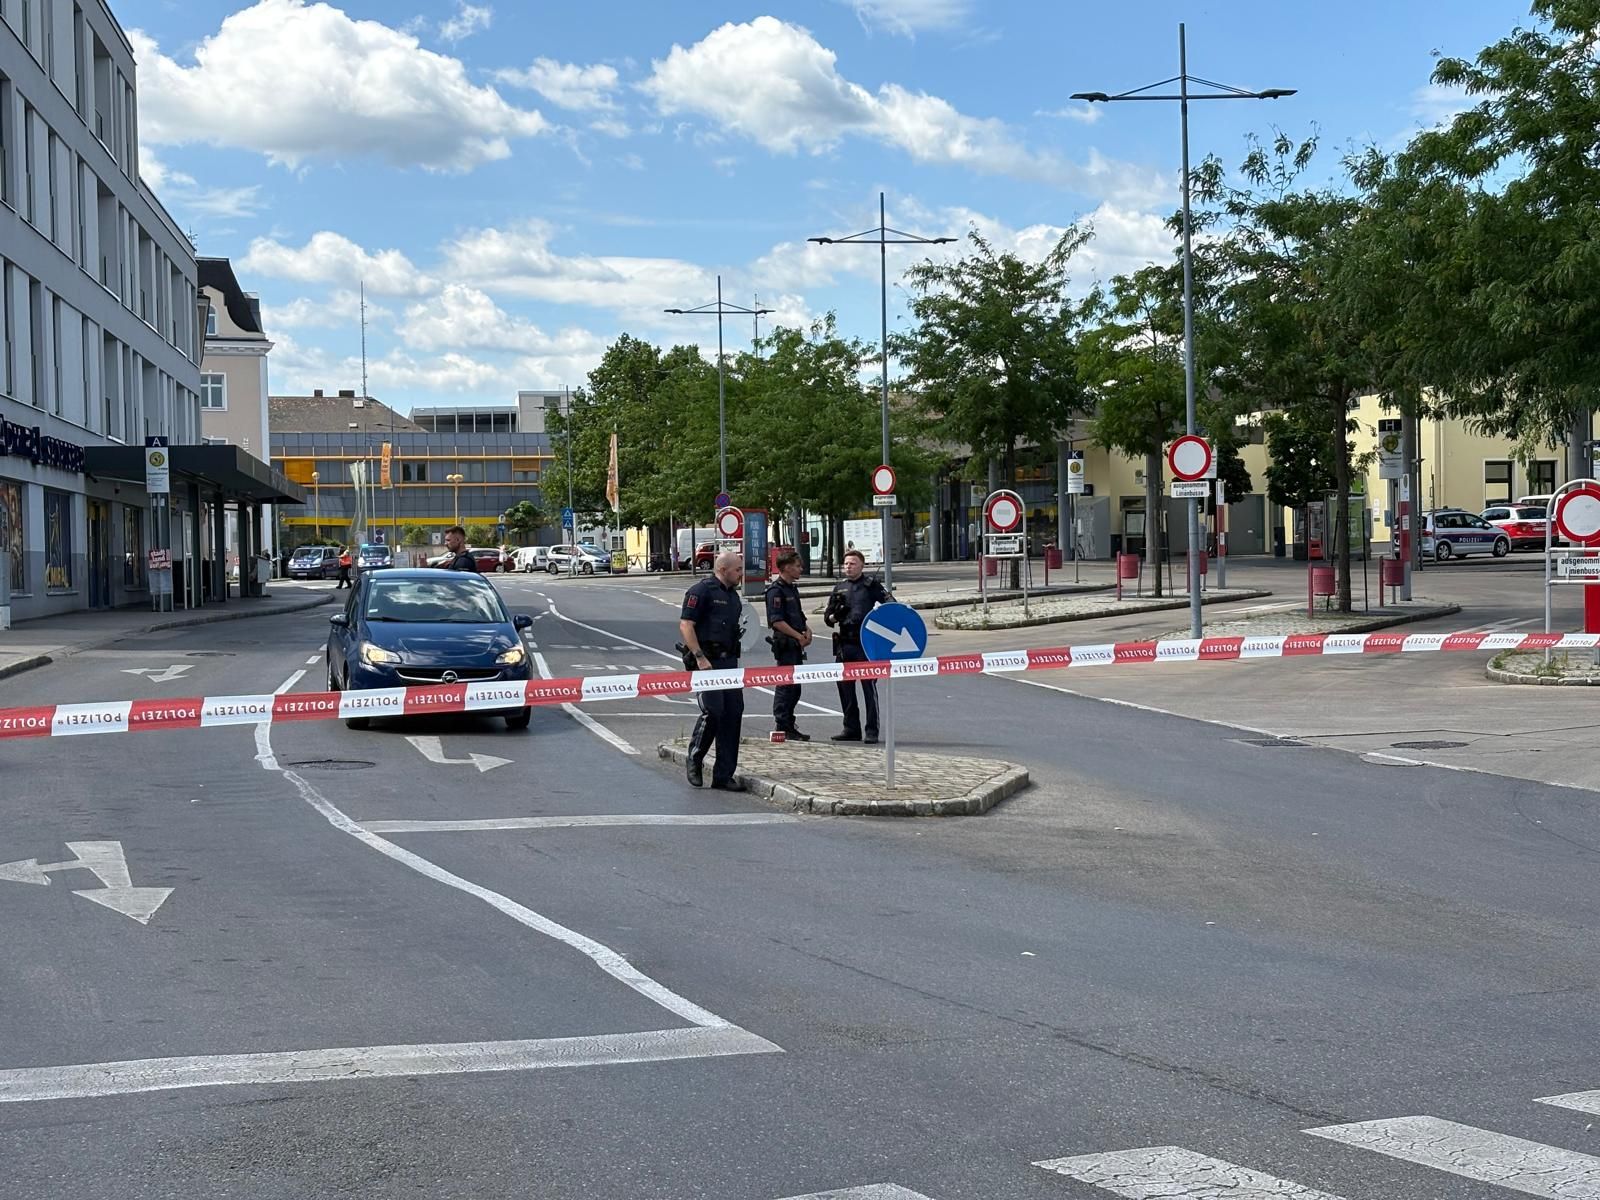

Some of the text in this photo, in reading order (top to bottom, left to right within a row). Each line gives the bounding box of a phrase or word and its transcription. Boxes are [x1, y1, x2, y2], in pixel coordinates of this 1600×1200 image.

[152, 437, 161, 446] A
[0, 717, 46, 729] POLIZ
[67, 713, 122, 725] POLIZEI
[142, 708, 196, 720] POLIZEI
[214, 704, 266, 716] POLIZEI
[285, 700, 334, 712] POLIZEI
[352, 696, 398, 708] POLIZEI
[416, 693, 460, 704] POLIZEI
[476, 690, 520, 701] POLIZEI
[536, 688, 577, 697] POLIZEI
[591, 683, 633, 694] POLIZEI
[647, 680, 687, 690] POLIZEI
[700, 678, 739, 687] POLIZEI
[752, 673, 790, 684] POLIZEI
[801, 671, 839, 680] POLIZEI
[850, 667, 888, 676] POLIZEI
[899, 664, 934, 673] POLIZEI
[946, 661, 981, 670] POLIZEI
[992, 658, 1025, 666] POLIZEI
[1036, 655, 1069, 664] POLIZEI
[1080, 652, 1112, 660] POLIZEI
[1121, 650, 1154, 658] POLIZEI
[1163, 647, 1195, 655] POLIZEI
[1206, 644, 1238, 653] POLIZEI
[1249, 642, 1280, 650] POLIZEI
[1289, 640, 1321, 648] POLIZEI
[1330, 639, 1361, 647] POLIZEI
[1371, 638, 1401, 646] POLIZEI
